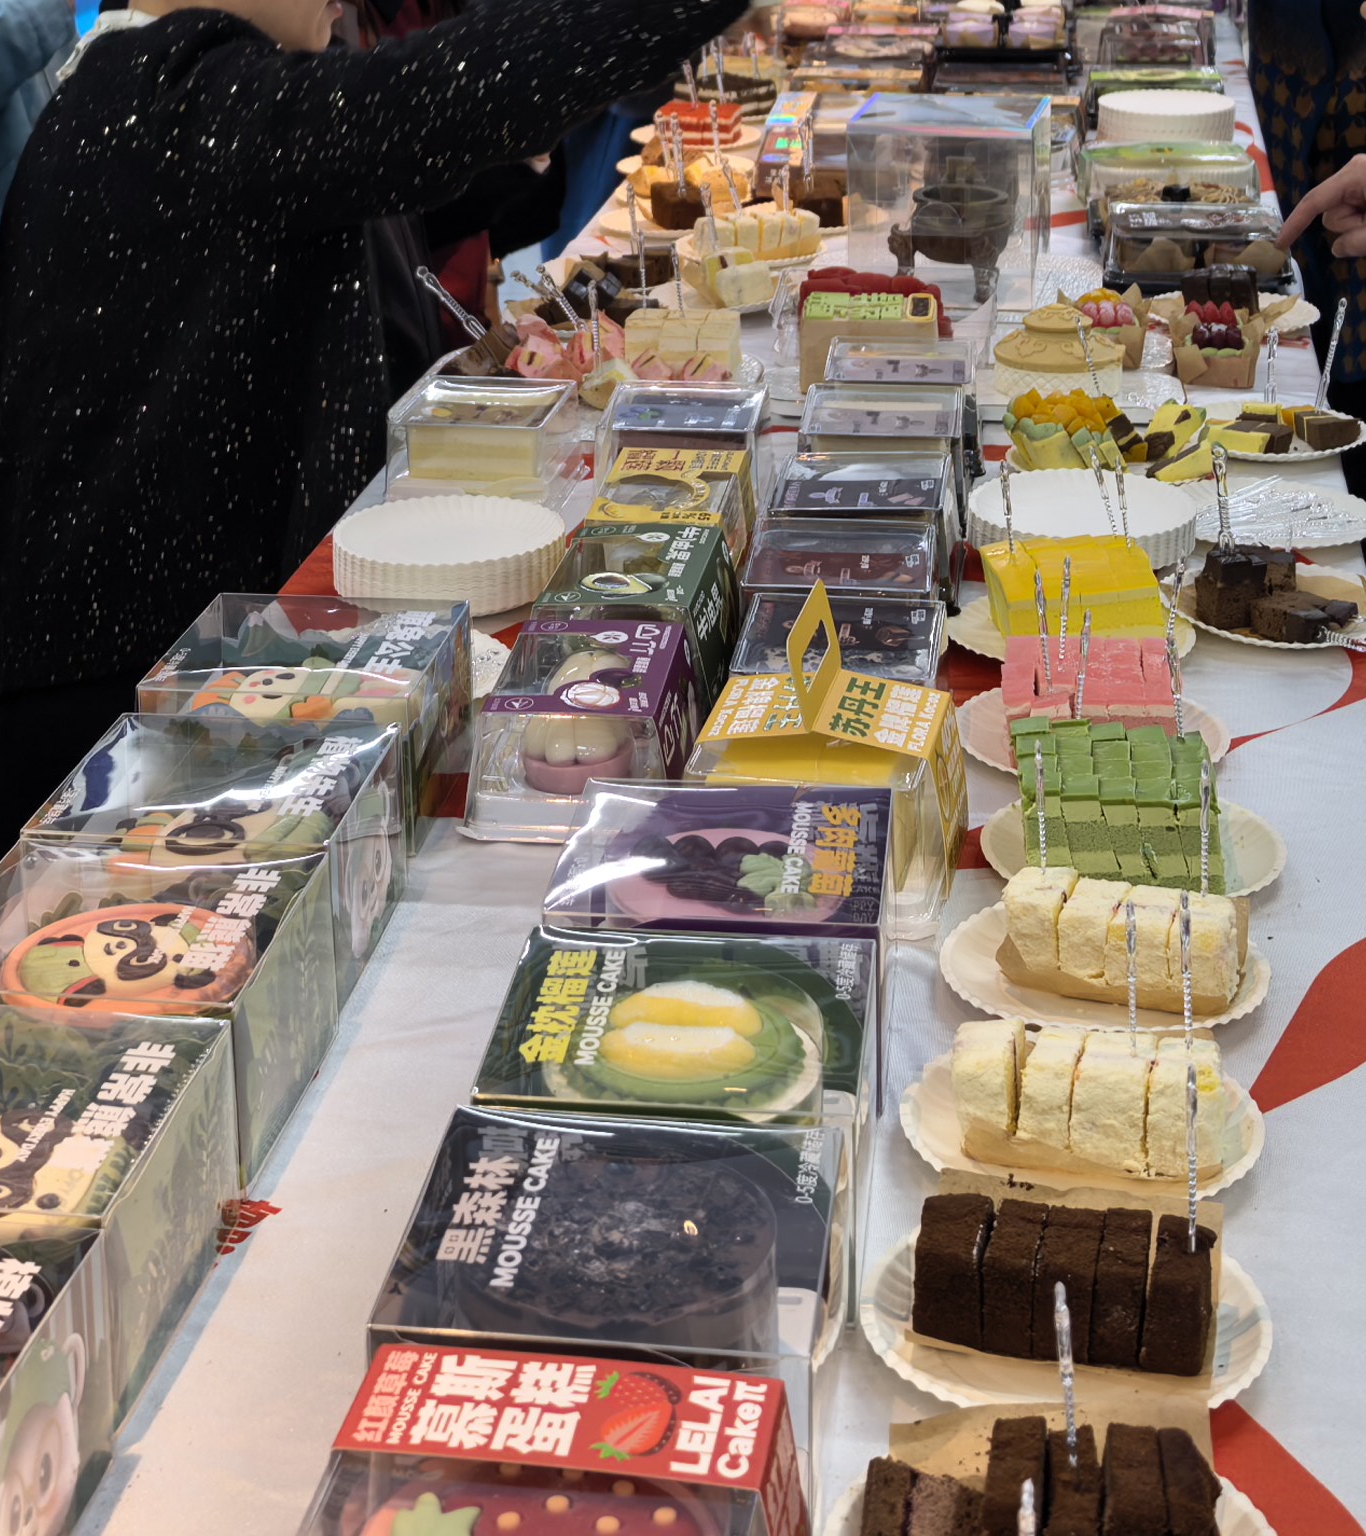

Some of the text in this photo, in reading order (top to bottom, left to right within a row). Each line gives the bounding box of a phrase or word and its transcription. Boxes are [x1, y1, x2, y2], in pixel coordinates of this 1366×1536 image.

[665, 526, 702, 561] 牛油果
[827, 676, 887, 738] 苏丹王
[873, 684, 923, 749] 金牌榴莲
[906, 719, 929, 753] FLORA
[780, 800, 815, 895] MOUSSE CAKE
[807, 802, 862, 898] 多肉葡萄
[179, 867, 283, 974] 非常熊猫
[518, 948, 598, 1065] 金枕榴莲
[573, 948, 627, 1066] MOUSSE CAKE
[436, 1155, 521, 1264] 黑森林
[488, 1137, 562, 1288] MOUSSE CAKE
[352, 1349, 420, 1443] 红颜草莓
[386, 1387, 420, 1444] MOUSSE
[415, 1352, 439, 1386] CAKE
[410, 1353, 518, 1449] 慕斯
[490, 1361, 597, 1457] 蛋糕
[670, 1375, 732, 1476] LELAI
